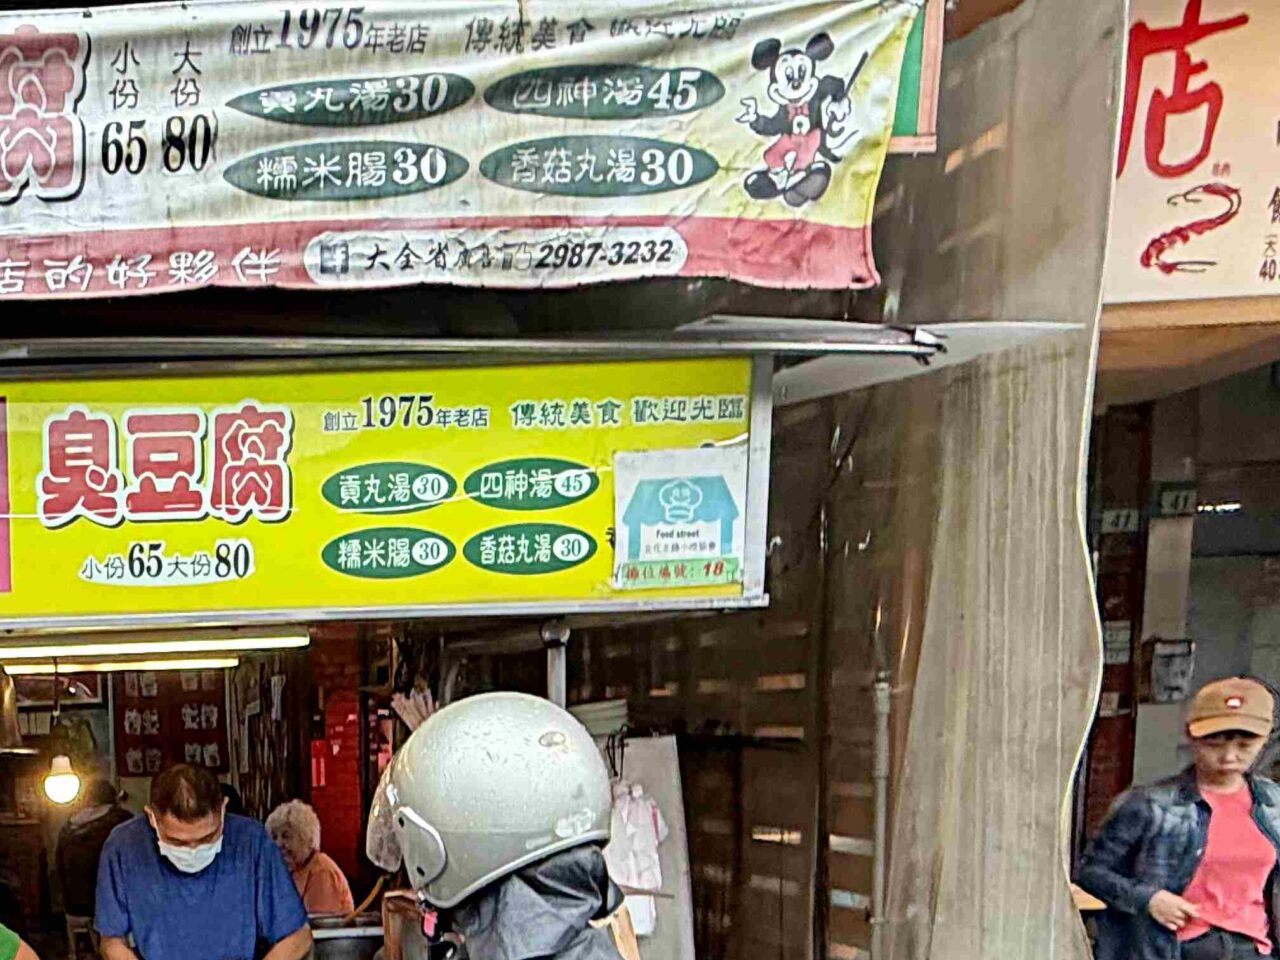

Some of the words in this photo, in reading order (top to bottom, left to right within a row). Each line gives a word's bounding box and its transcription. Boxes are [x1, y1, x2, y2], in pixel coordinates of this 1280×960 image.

[110, 40, 140, 110] 小份
[170, 40, 202, 107] 大份
[101, 119, 147, 175] 65
[163, 114, 211, 172] 80
[534, 239, 675, 269] 2987-3232
[323, 394, 489, 432] 創立1975年老店
[511, 400, 621, 427] 傳統美食
[633, 396, 744, 424] 歡迎光臨
[40, 403, 292, 527] 臭豆腐
[479, 468, 553, 500] 四神湯
[561, 473, 583, 493] 45
[338, 474, 412, 505] 貢丸湯
[420, 476, 441, 496] 30
[337, 537, 411, 569] 糯米腸
[420, 541, 441, 560] 30
[479, 533, 552, 565] 香菇丸湯
[560, 538, 582, 558] 30
